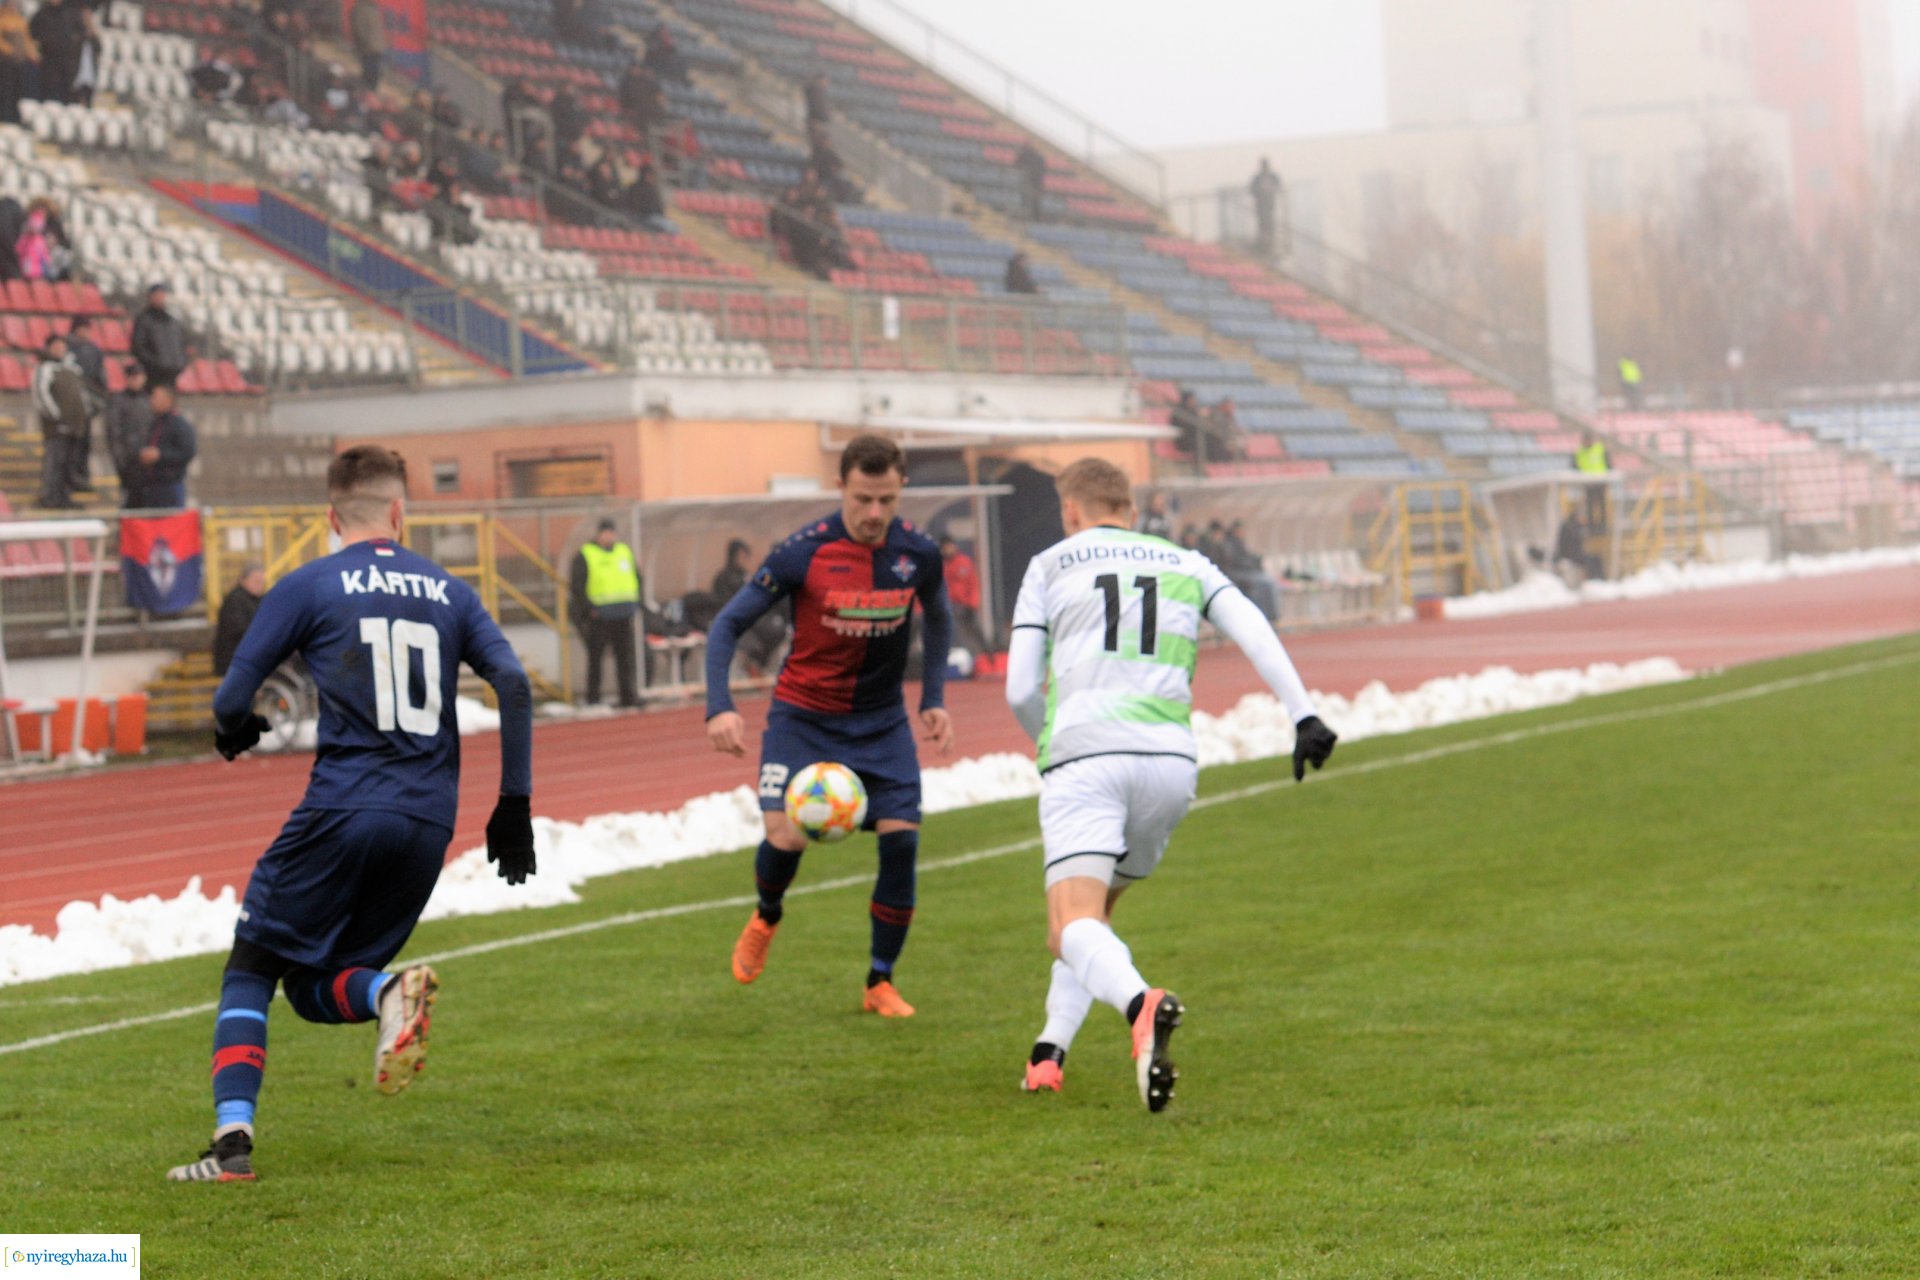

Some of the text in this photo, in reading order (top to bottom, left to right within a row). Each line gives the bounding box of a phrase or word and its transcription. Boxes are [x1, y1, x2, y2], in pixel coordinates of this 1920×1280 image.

[340, 564, 450, 605] KÁRTIK
[1094, 573, 1157, 655] 11
[359, 617, 442, 736] 10
